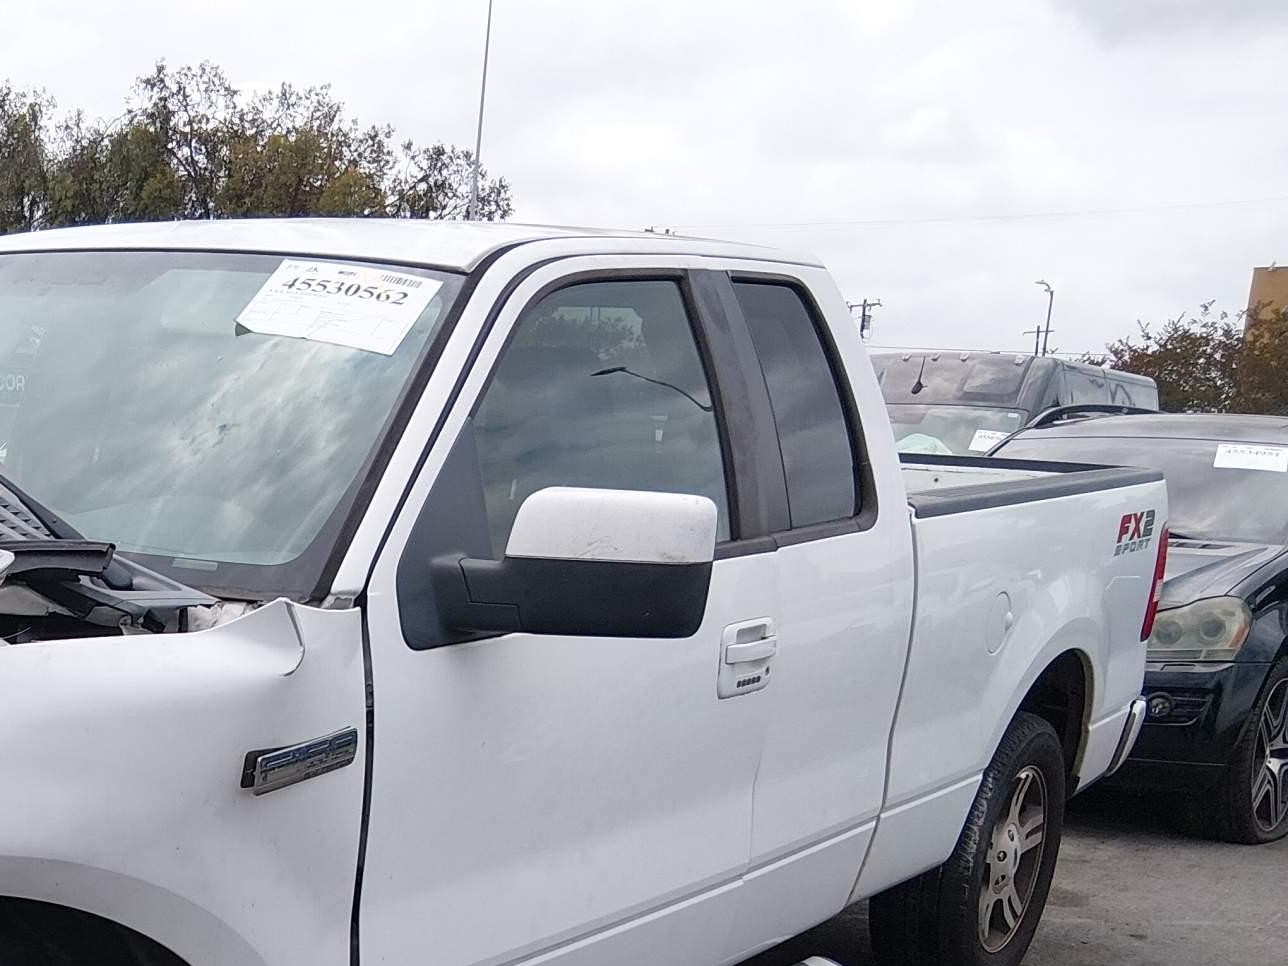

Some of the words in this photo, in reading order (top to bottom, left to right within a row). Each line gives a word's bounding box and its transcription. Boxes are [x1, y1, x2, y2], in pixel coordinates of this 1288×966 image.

[281, 276, 409, 305] 45530562
[1116, 508, 1156, 545] FX2
[1113, 537, 1152, 557] SPORT
